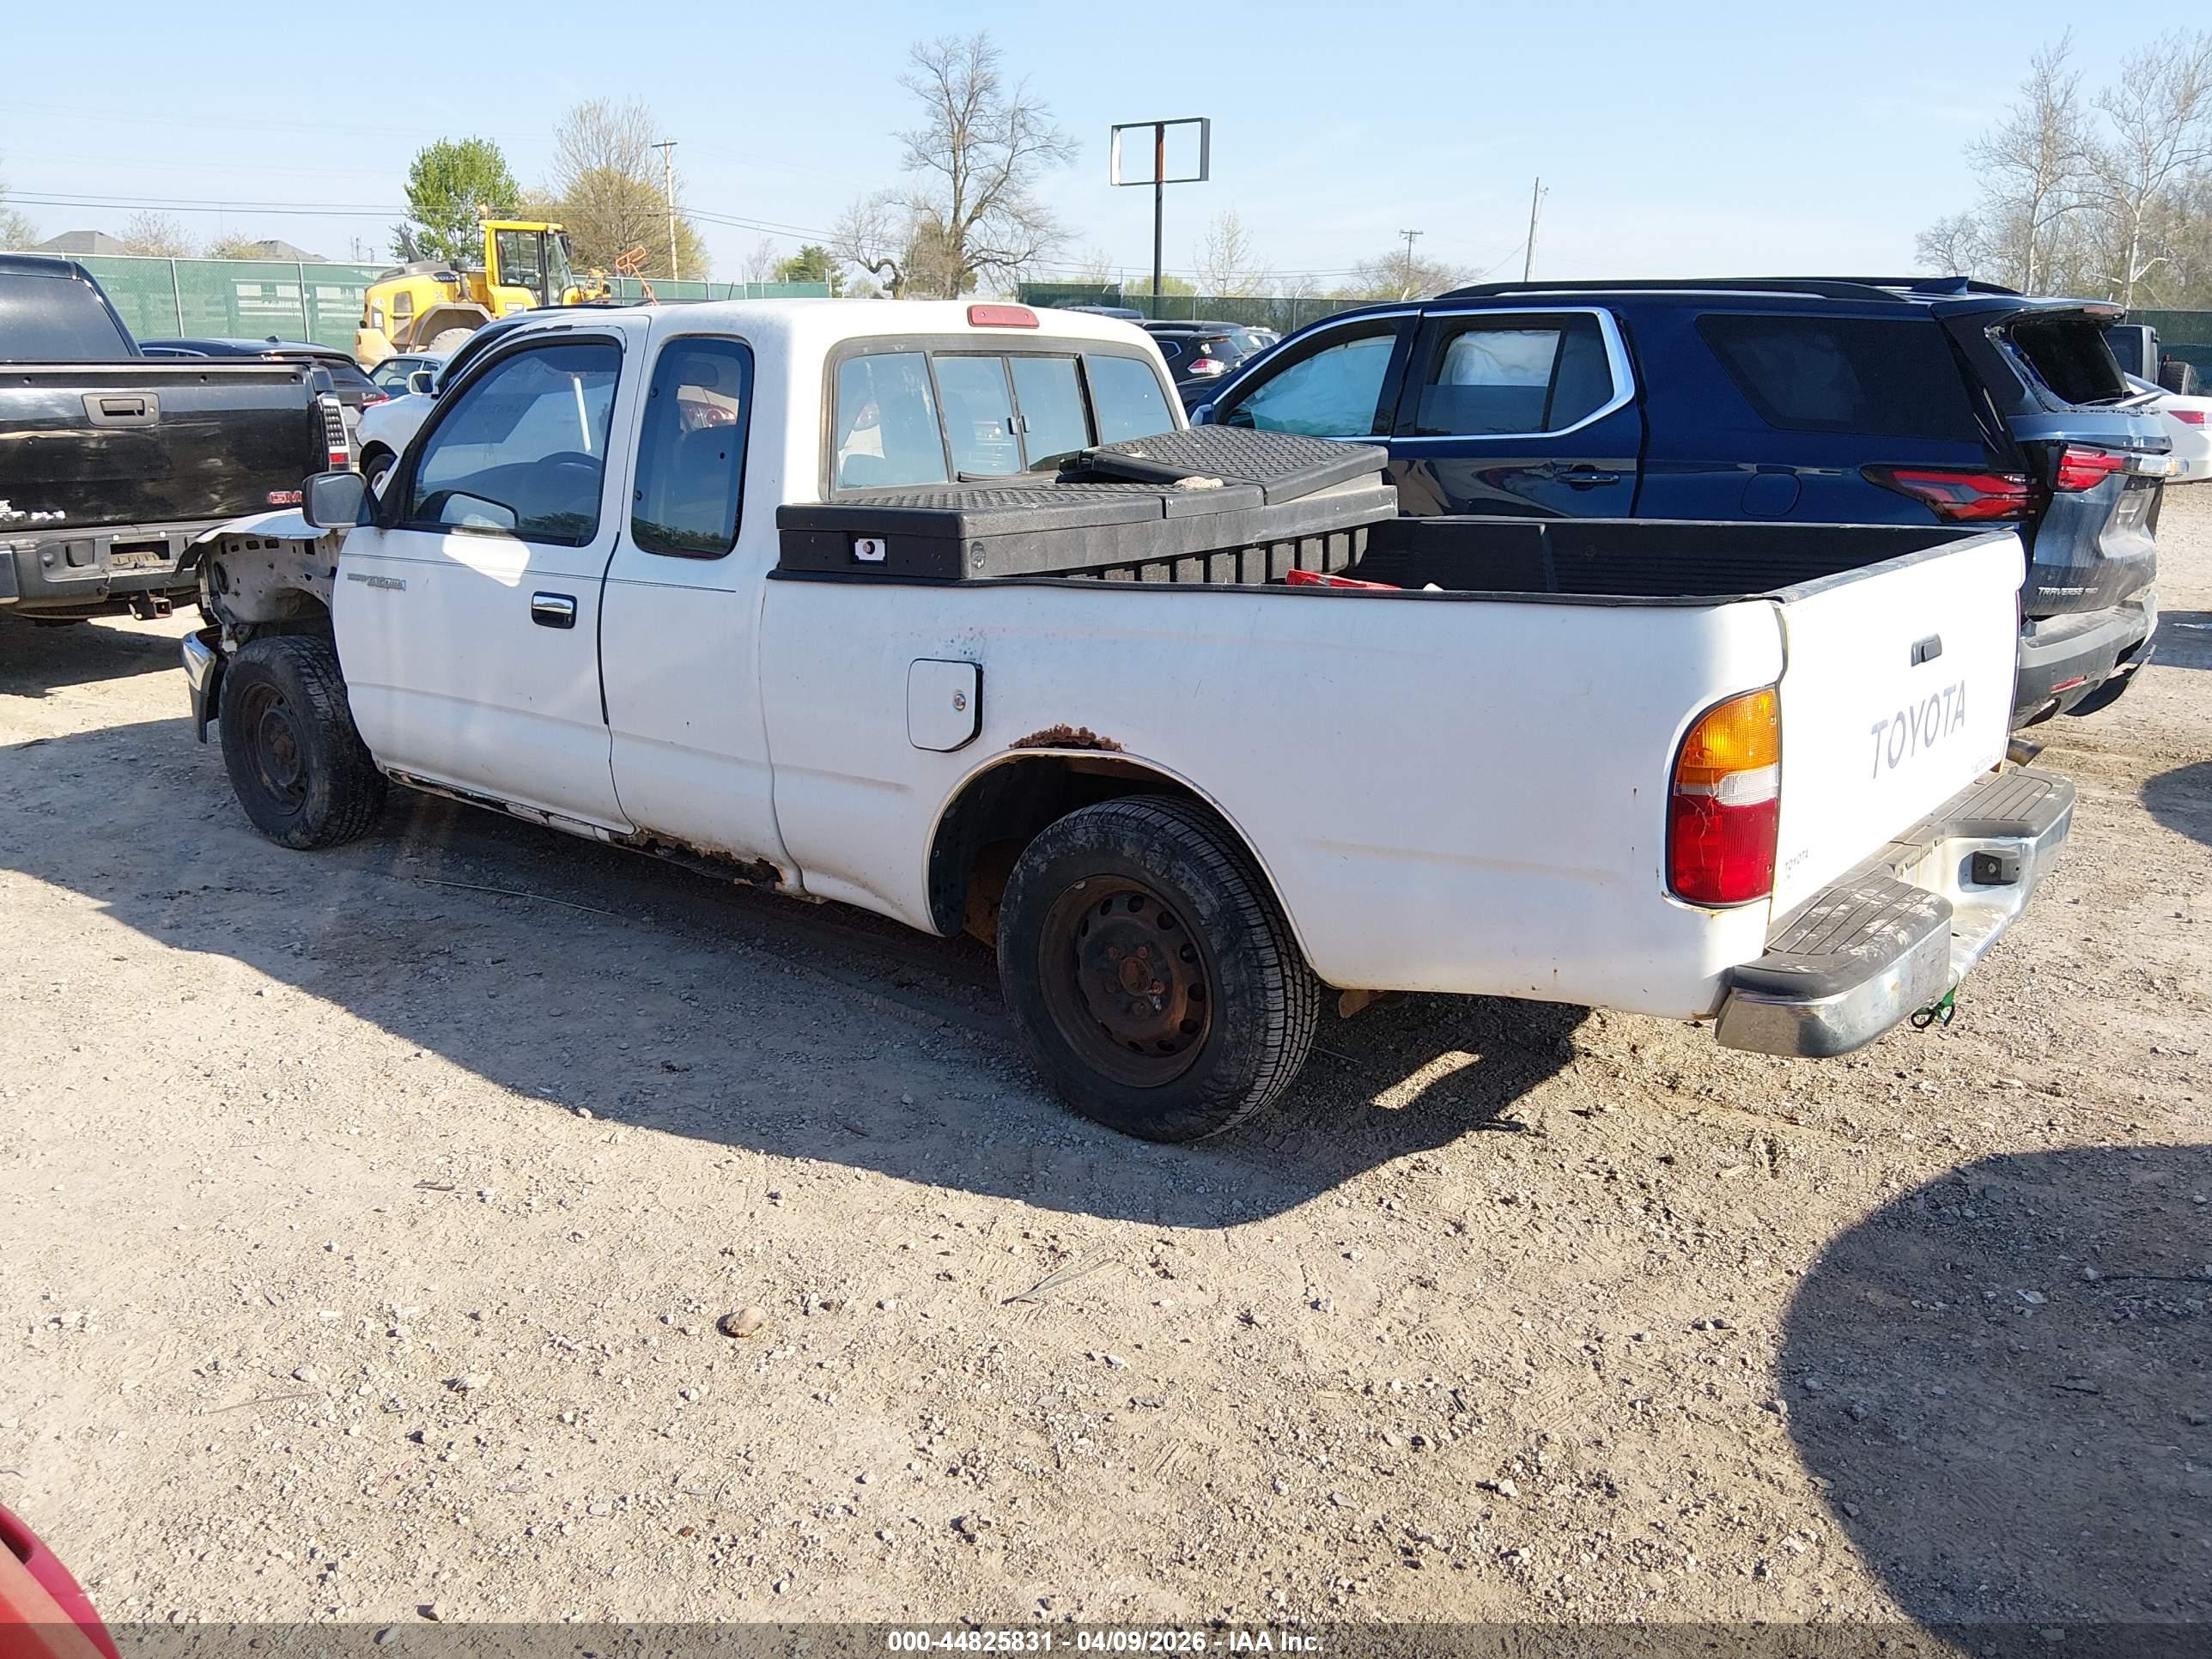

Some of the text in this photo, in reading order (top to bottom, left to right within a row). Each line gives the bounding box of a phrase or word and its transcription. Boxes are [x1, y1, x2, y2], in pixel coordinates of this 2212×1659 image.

[269, 490, 302, 504] GM
[2038, 586, 2084, 596] TRAVERSE
[1871, 679, 1965, 780] TOYOTA
